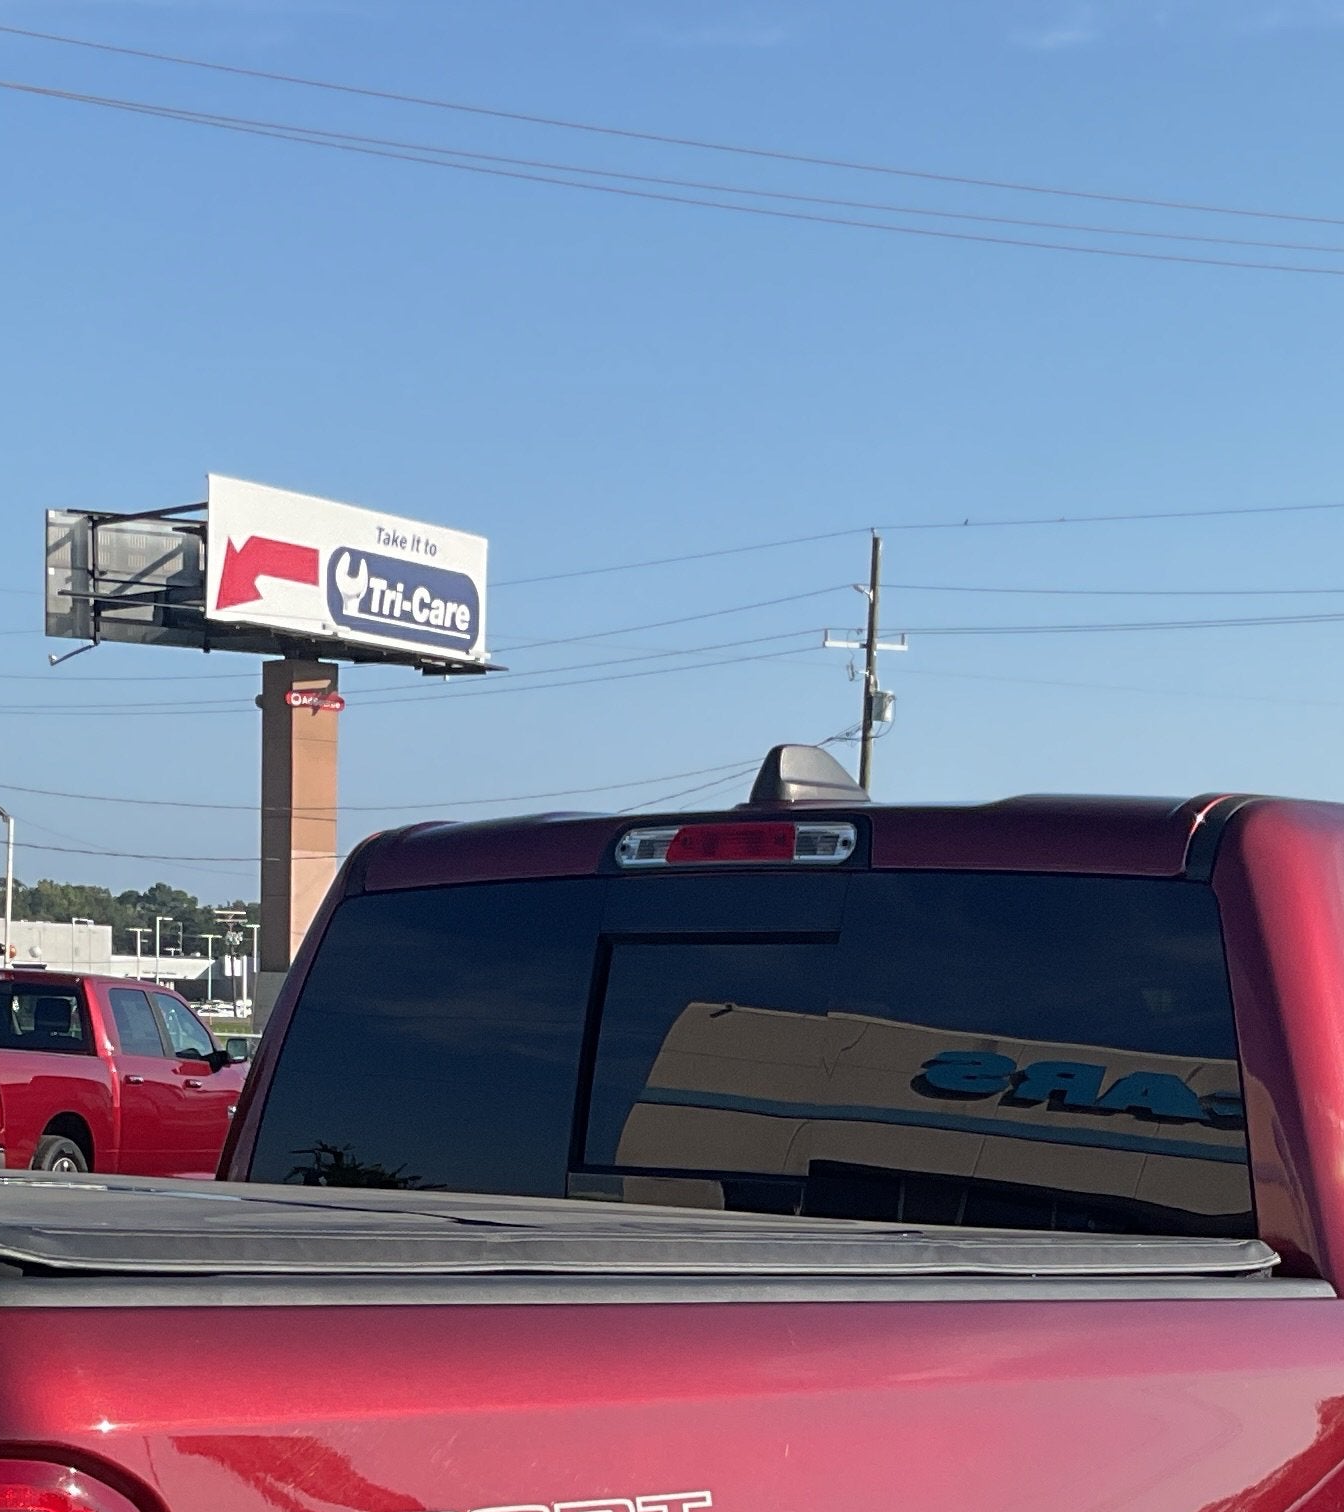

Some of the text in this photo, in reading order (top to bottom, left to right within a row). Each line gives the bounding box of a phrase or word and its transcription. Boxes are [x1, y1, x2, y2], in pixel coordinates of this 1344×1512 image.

[375, 525, 408, 550] Take
[423, 538, 438, 557] to
[369, 574, 471, 632] Tri-Care
